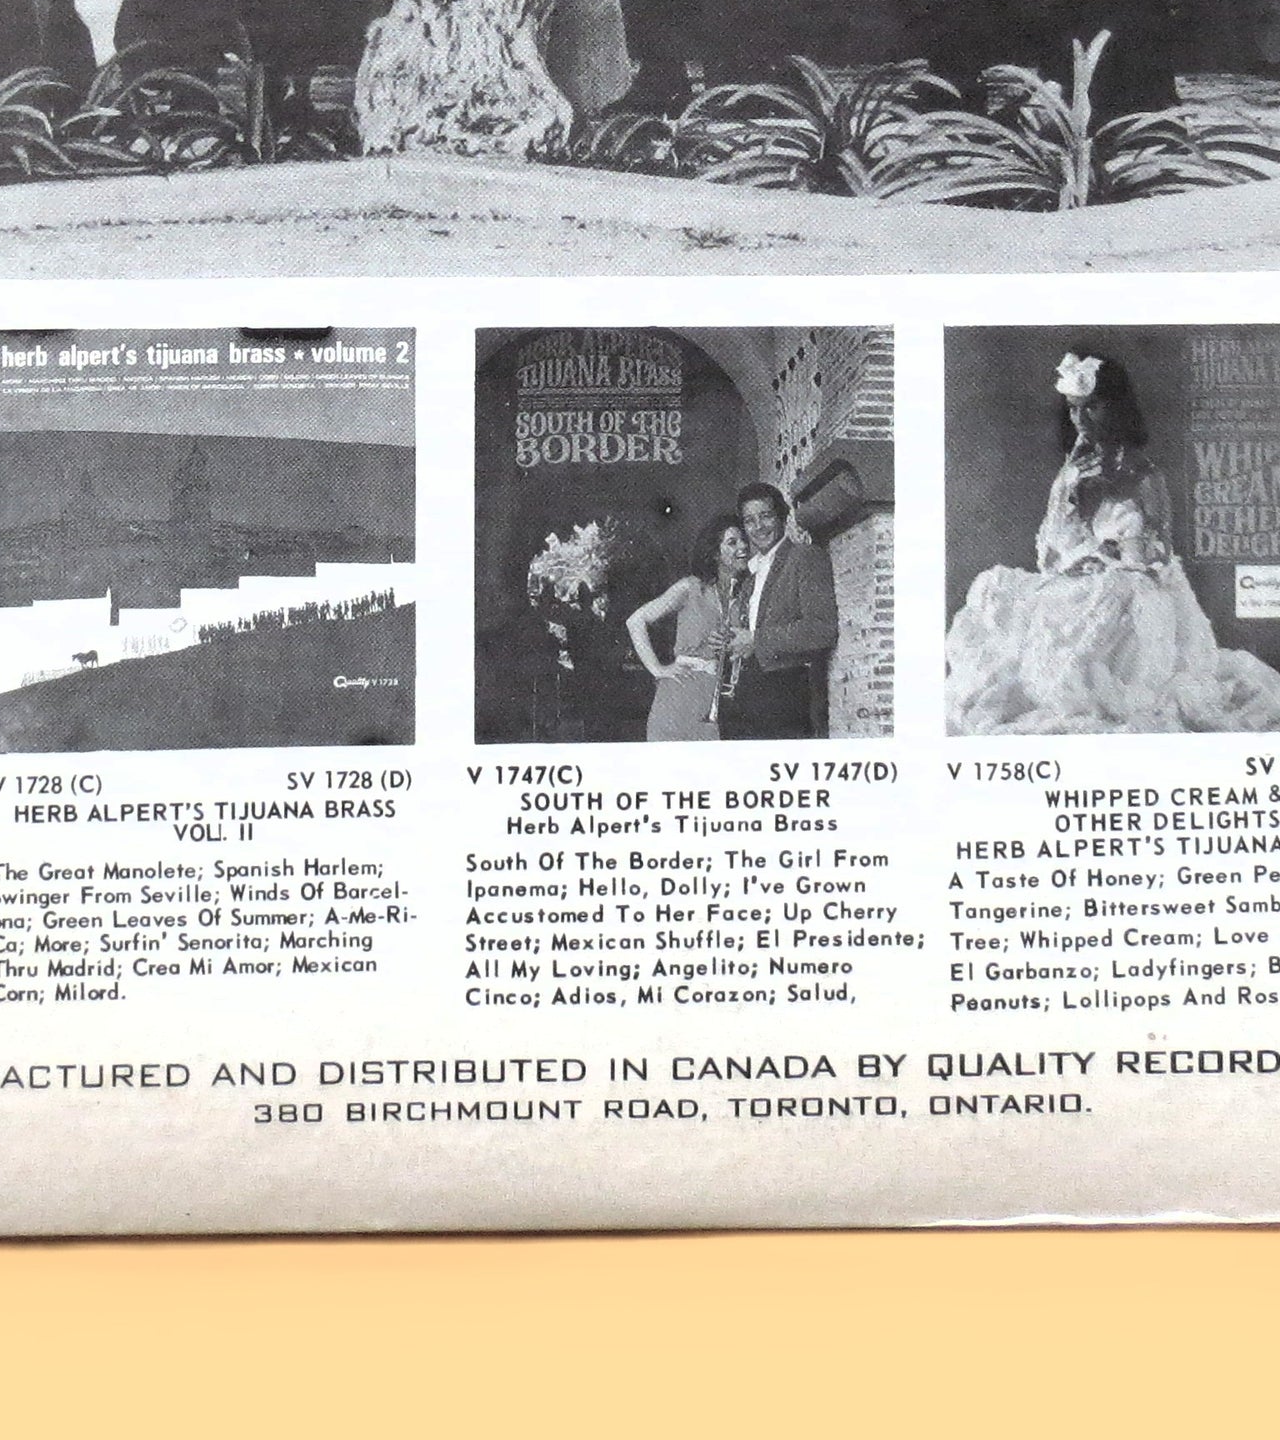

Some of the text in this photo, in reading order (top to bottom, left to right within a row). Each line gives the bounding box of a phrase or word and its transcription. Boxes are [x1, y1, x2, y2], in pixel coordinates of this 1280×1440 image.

[1, 341, 410, 371] herb alpert's tijuana brass volume 2
[516, 410, 594, 440] SOUTH
[599, 410, 626, 433] OF
[516, 433, 683, 468] BORDER
[467, 765, 582, 788] V 1747(C)
[770, 761, 897, 784] SV 1747(D)
[947, 760, 1061, 783] V 1758(C)
[1246, 757, 1274, 776] SV
[16, 775, 62, 794] 1728
[71, 775, 102, 796] (C)
[287, 769, 412, 791] SV 1728 (D)
[521, 789, 830, 811] SOUTH OF THE BORDER
[1045, 788, 1159, 808] WHIPPED
[1171, 787, 1258, 806] CREAM
[15, 799, 395, 823] HERB ALPERT'S TIJUANA BRASS
[1055, 810, 1280, 833] OTHER DELIGHTS
[239, 823, 252, 841] II
[957, 840, 1025, 860] HERB
[1037, 836, 1165, 858] ALPERT'S
[39, 862, 94, 881] Great
[104, 861, 203, 881] Manolete;
[214, 858, 294, 882] Spanish
[304, 857, 382, 878] Harlem;
[465, 928, 924, 955] Street; Mexican Shuffle; El Presidente;
[951, 962, 973, 981] El
[986, 961, 1099, 982] Garbanzo;
[1112, 958, 1255, 981] Ladyfingers;
[212, 1062, 296, 1086] AND
[319, 1059, 586, 1085] DISTRIBUTED
[610, 1058, 647, 1081] IN
[672, 1055, 837, 1080] CANADA
[858, 1054, 907, 1078] BY
[928, 1052, 1095, 1081] QUALITY
[255, 1094, 1091, 1123] 380 BIRCHMOUNT ROAD, TORONTO, ONTARIO.
